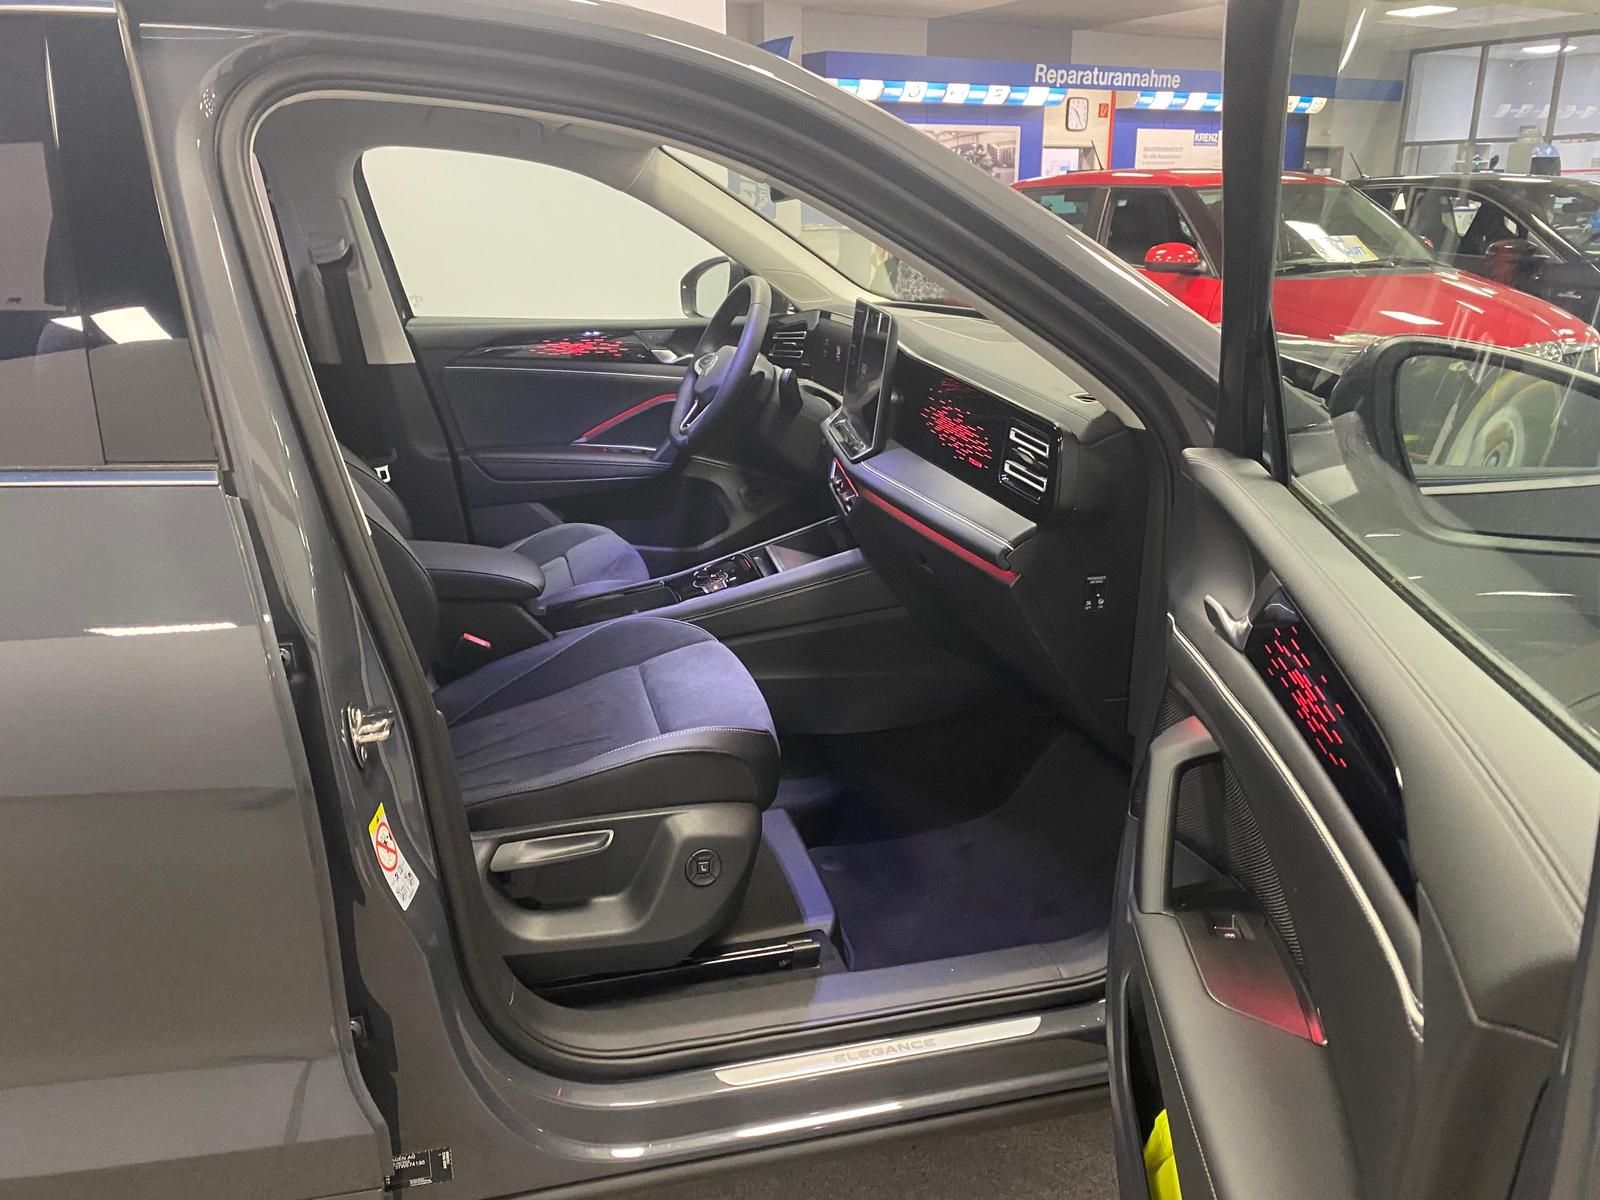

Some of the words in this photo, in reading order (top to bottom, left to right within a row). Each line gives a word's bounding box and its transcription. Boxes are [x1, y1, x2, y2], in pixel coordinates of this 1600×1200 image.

[1034, 63, 1181, 89] Reparaturannahme
[1195, 132, 1218, 142] KRENZ
[833, 1038, 937, 1063] ELEGANCE
